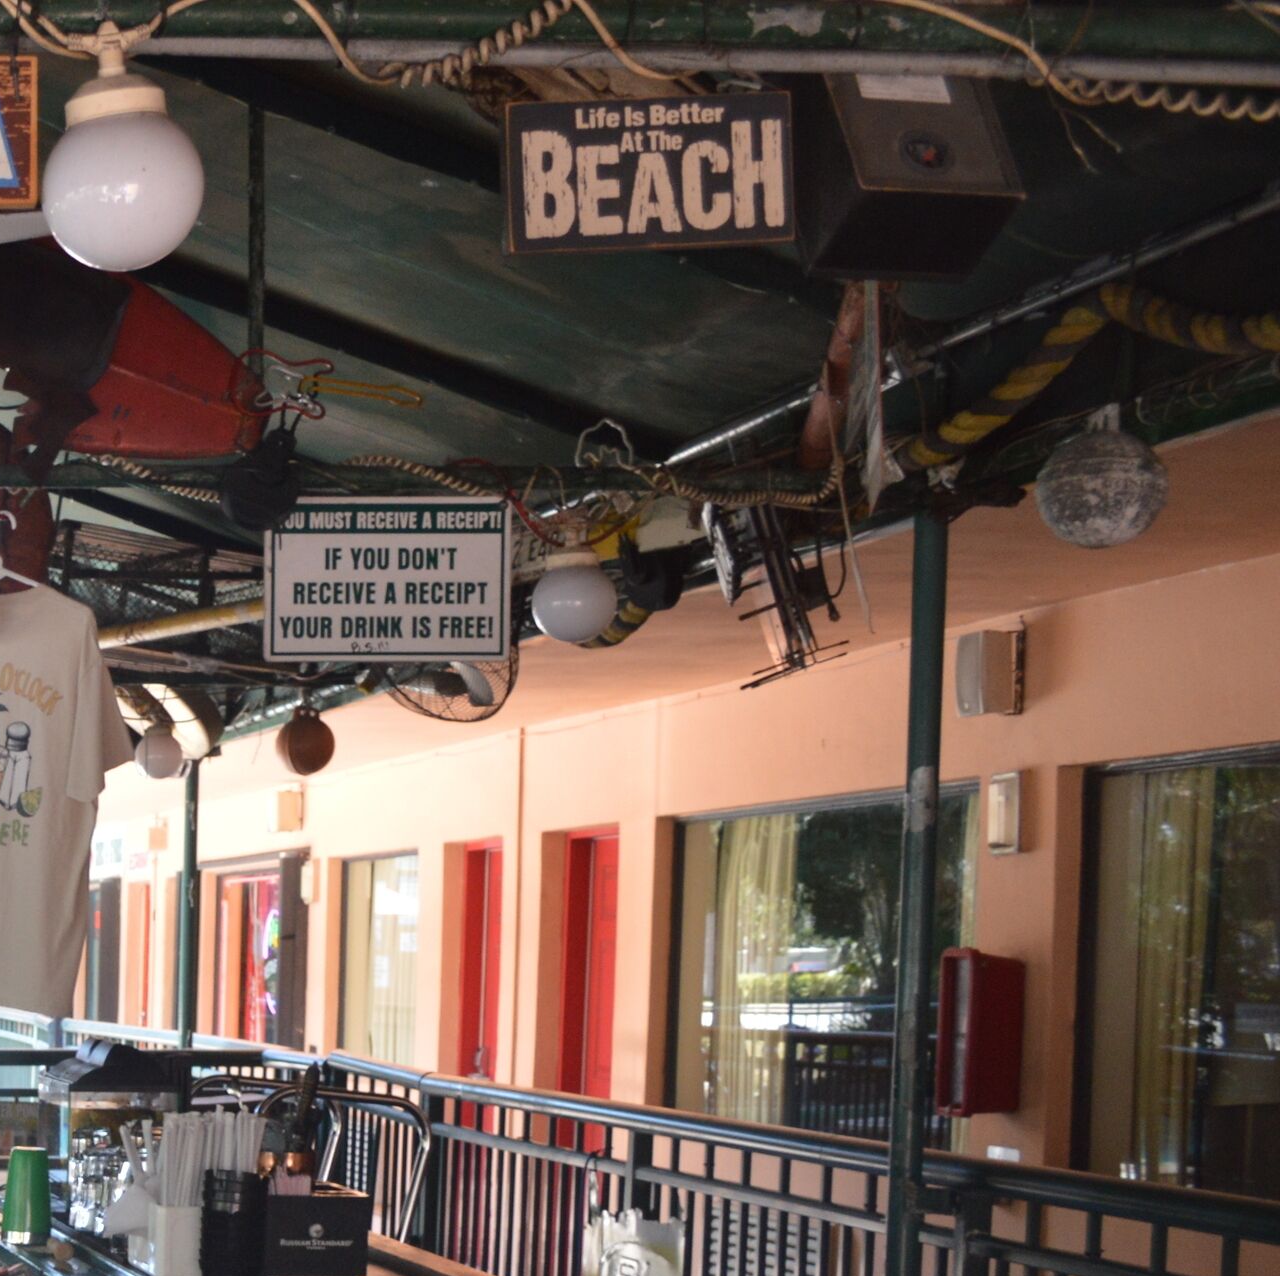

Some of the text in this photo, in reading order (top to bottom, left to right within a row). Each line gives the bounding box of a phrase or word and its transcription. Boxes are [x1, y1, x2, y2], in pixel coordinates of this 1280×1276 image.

[575, 102, 724, 129] Life Is Better
[619, 130, 683, 153] At The
[520, 118, 786, 240] BEACH
[281, 510, 502, 530] OU MUST RECEIVE A RECEIPT!
[324, 547, 458, 571] IF YOU DON'T
[293, 582, 488, 605] RECEIVE A RECEIPT
[280, 616, 494, 639] YOUR DRINK IS FREE!
